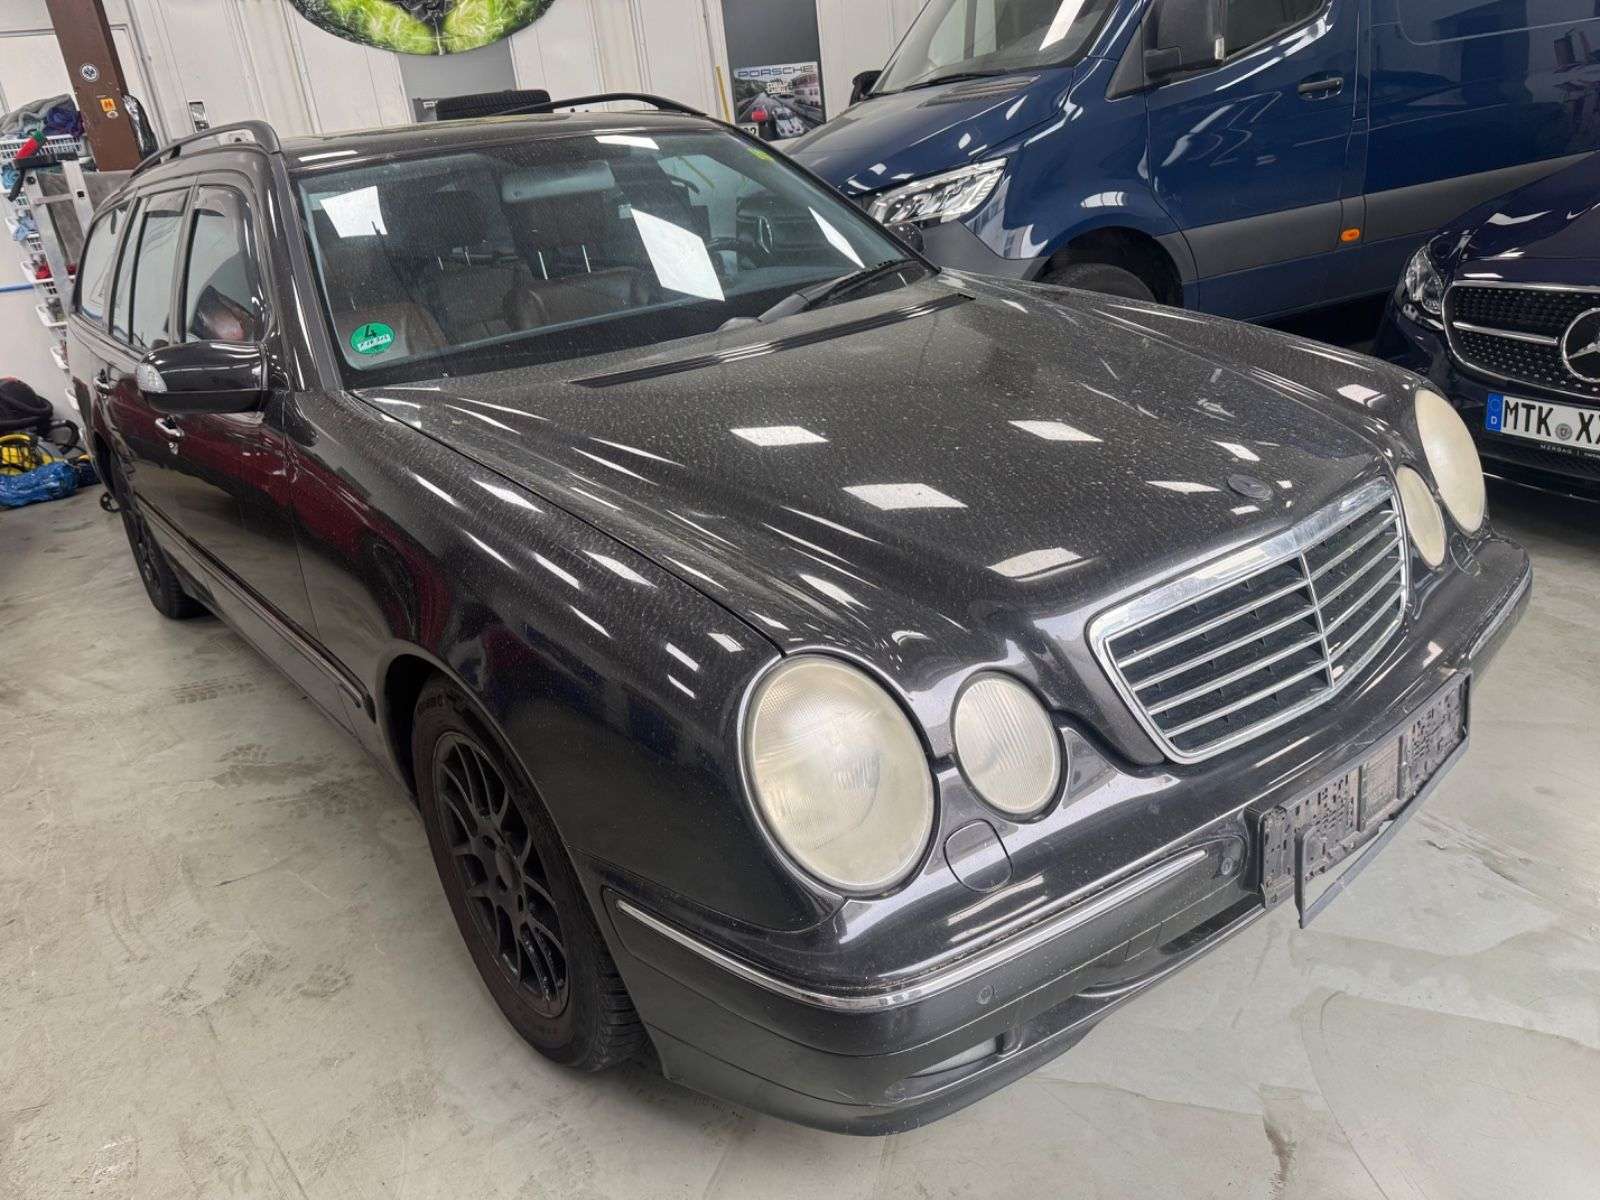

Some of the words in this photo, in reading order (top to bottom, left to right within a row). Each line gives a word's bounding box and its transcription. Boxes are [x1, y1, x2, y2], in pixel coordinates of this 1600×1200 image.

[737, 65, 816, 78] PORSCHE
[364, 324, 377, 338] 4
[1490, 415, 1498, 425] D
[1502, 399, 1554, 437] MTK
[1575, 411, 1600, 445] X
